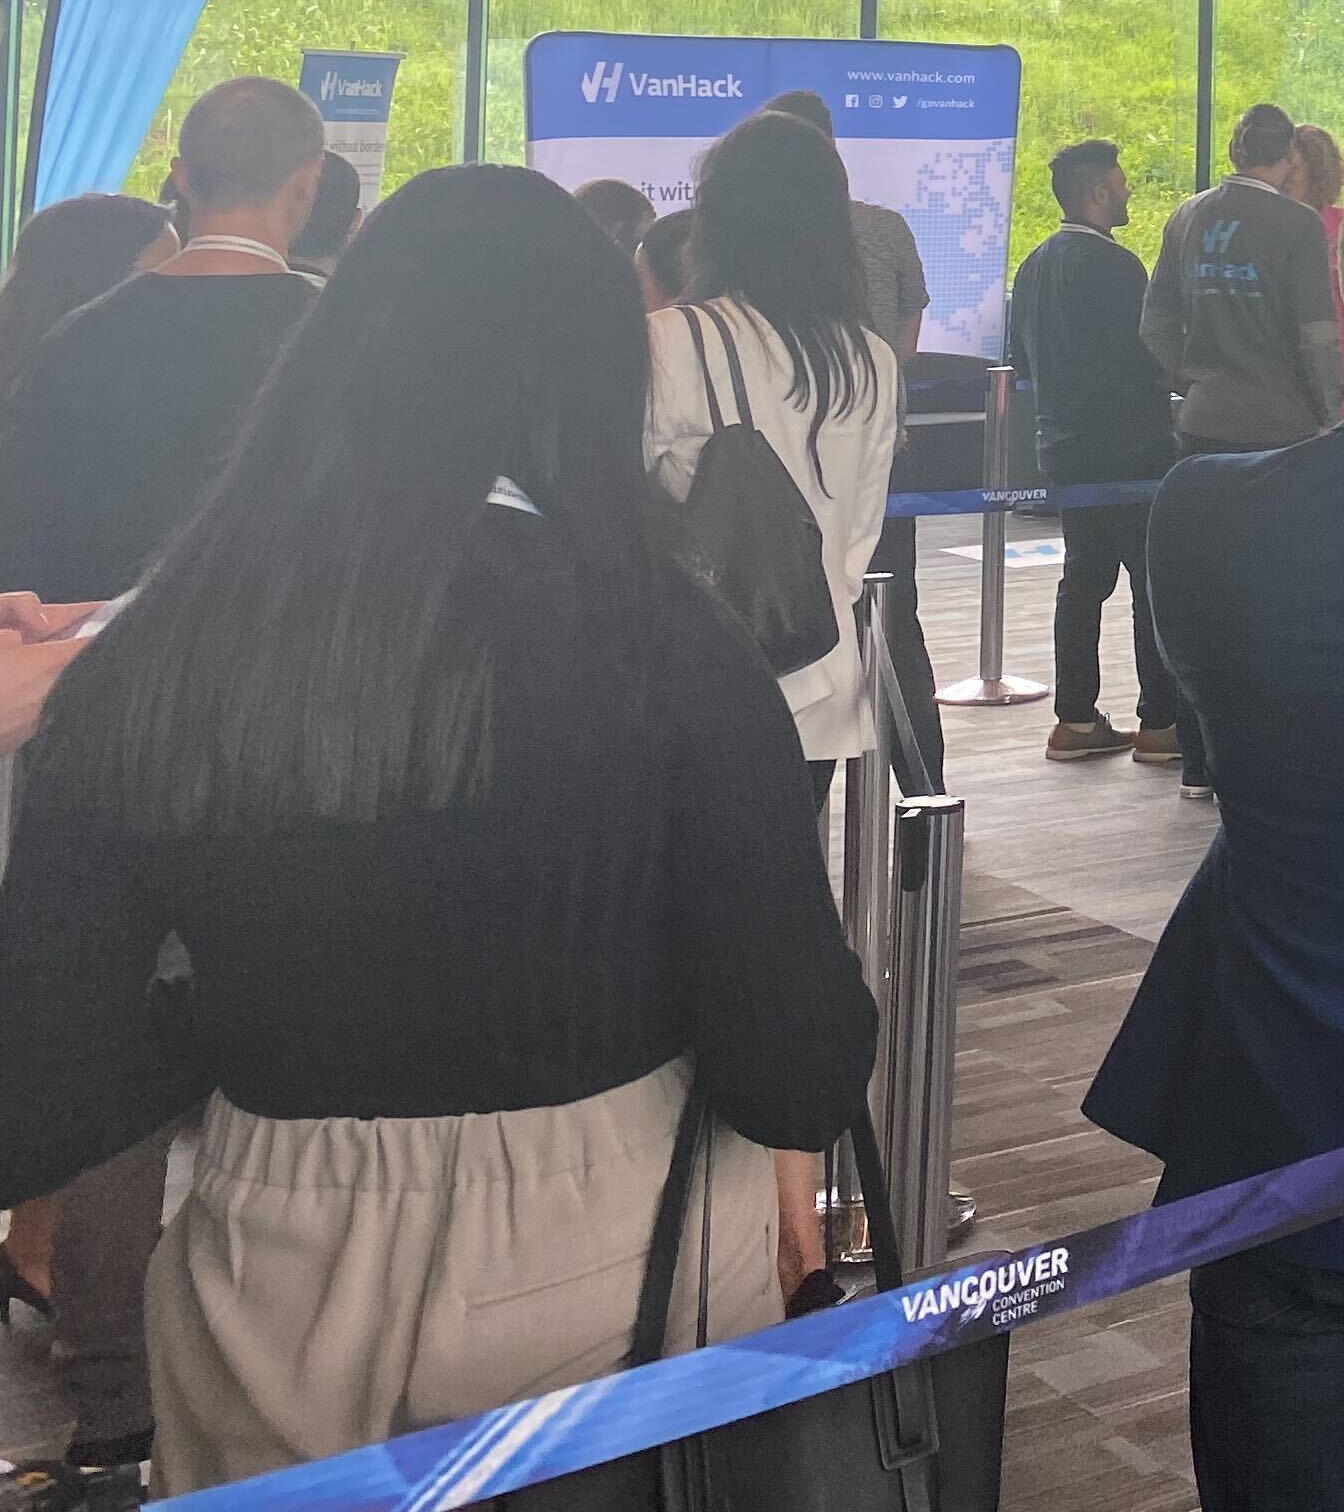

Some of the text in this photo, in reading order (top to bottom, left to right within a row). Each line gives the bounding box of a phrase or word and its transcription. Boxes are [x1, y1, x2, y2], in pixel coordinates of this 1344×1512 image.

[628, 72, 743, 98] VanHack
[847, 70, 975, 84] www.vanhack.com
[982, 488, 1047, 502] VANCOUVER
[902, 1247, 1069, 1323] VANCOUVER
[992, 1278, 1065, 1312] CONVENTION
[992, 1301, 1038, 1326] CENTRE
